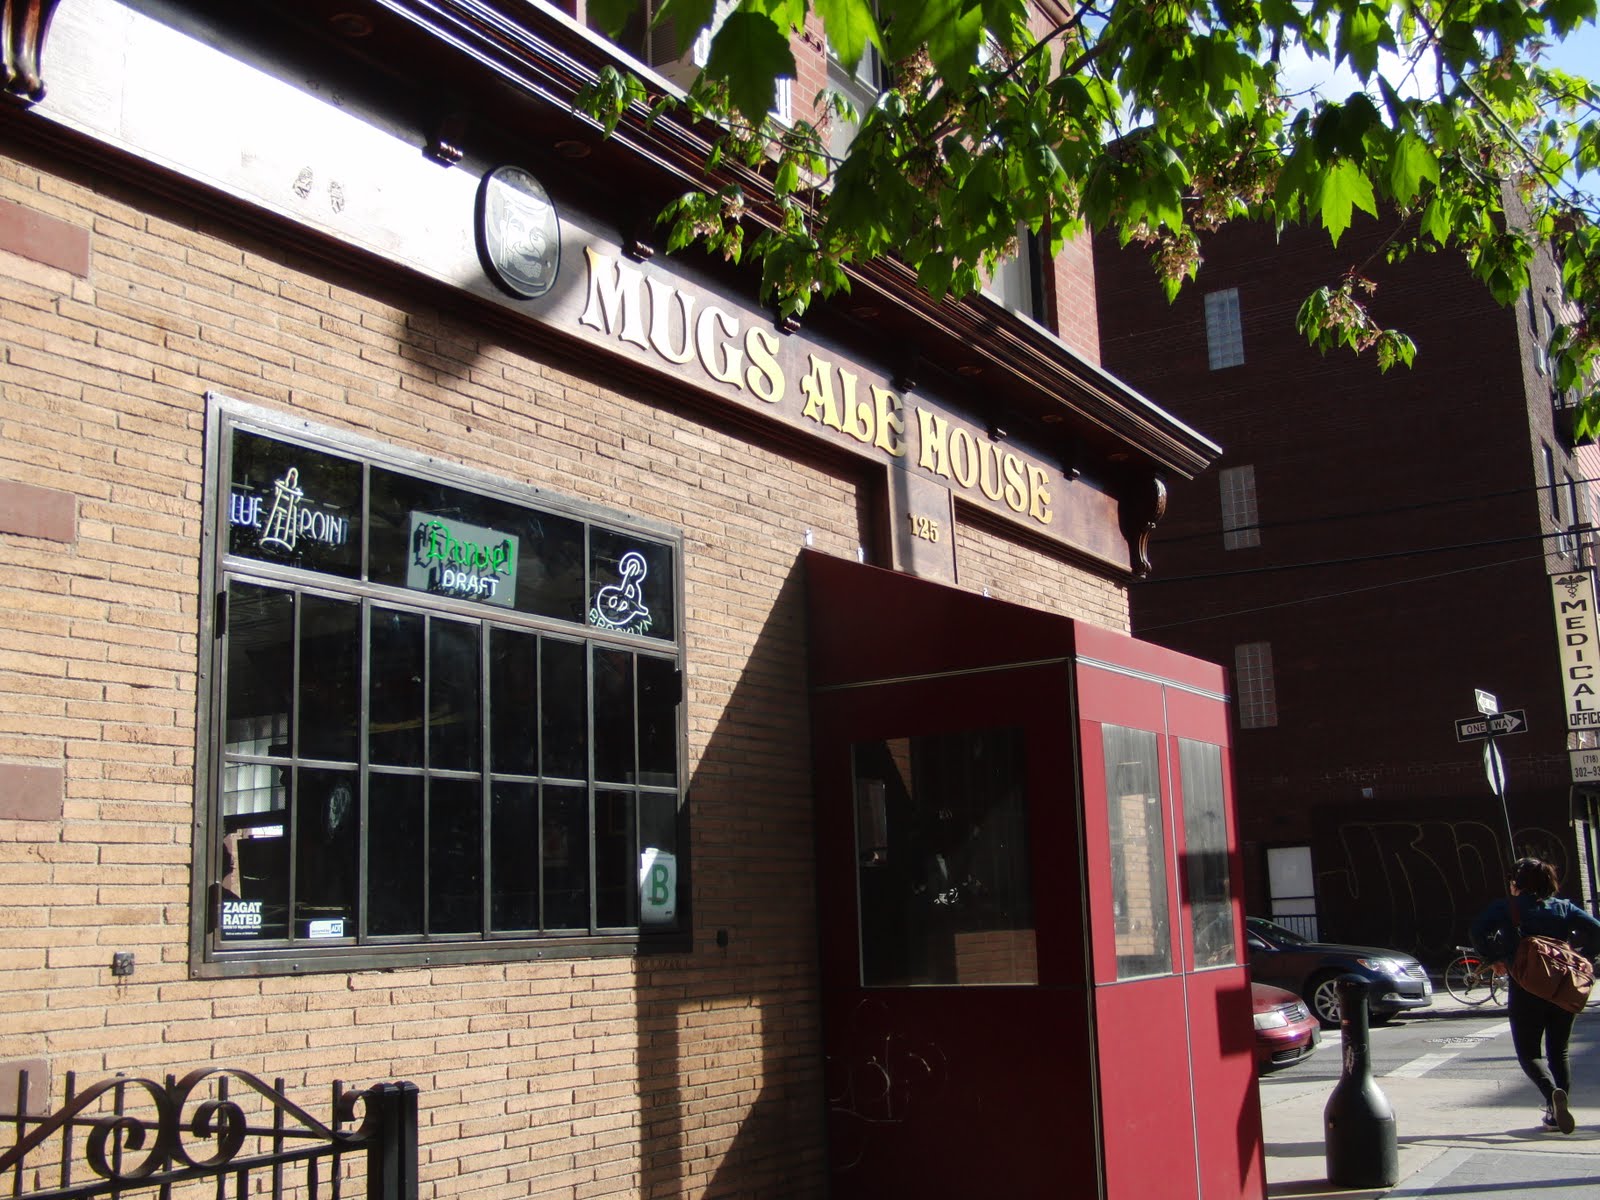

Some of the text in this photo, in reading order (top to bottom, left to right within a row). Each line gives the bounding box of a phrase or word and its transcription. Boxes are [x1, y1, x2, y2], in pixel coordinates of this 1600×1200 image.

[580, 245, 1054, 525] MUGS ALE HOUSE
[907, 512, 940, 544] 125
[442, 569, 499, 597] DRAFT
[1560, 599, 1596, 712] MEDICAL
[1466, 718, 1515, 734] ONE WAY
[1583, 754, 1599, 765] (718)
[651, 864, 669, 906] B
[223, 902, 262, 914] ZAGAT
[223, 914, 262, 925] RATED
